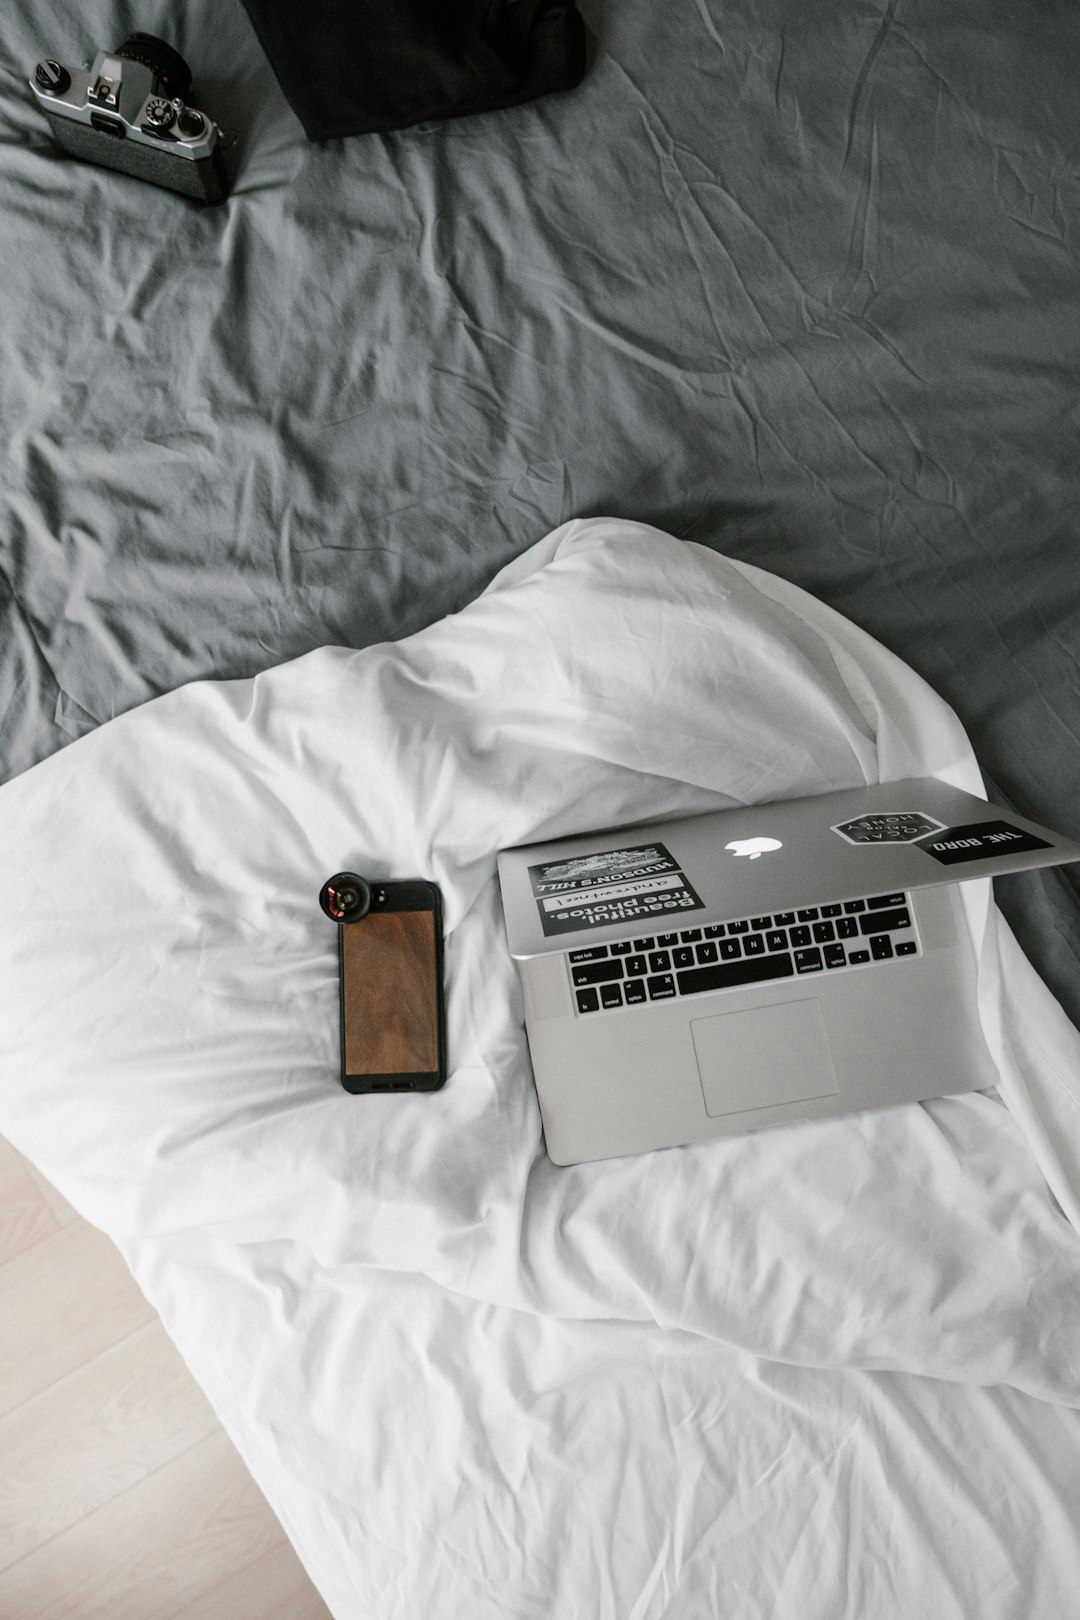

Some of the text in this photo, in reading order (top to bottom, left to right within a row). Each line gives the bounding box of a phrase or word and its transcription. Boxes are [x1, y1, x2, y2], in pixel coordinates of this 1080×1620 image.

[847, 814, 914, 831] HONEY
[858, 825, 932, 841] LOCAL
[932, 831, 1023, 852] THE BORO
[536, 861, 674, 892] HUDSON'S HILL
[550, 890, 691, 920] free photos.
[582, 898, 696, 924] Beautiful,
[727, 944, 734, 952] B
[750, 940, 757, 948] N
[680, 953, 687, 961] C
[703, 949, 710, 957] V
[633, 961, 640, 970] Z
[656, 957, 664, 966] X
